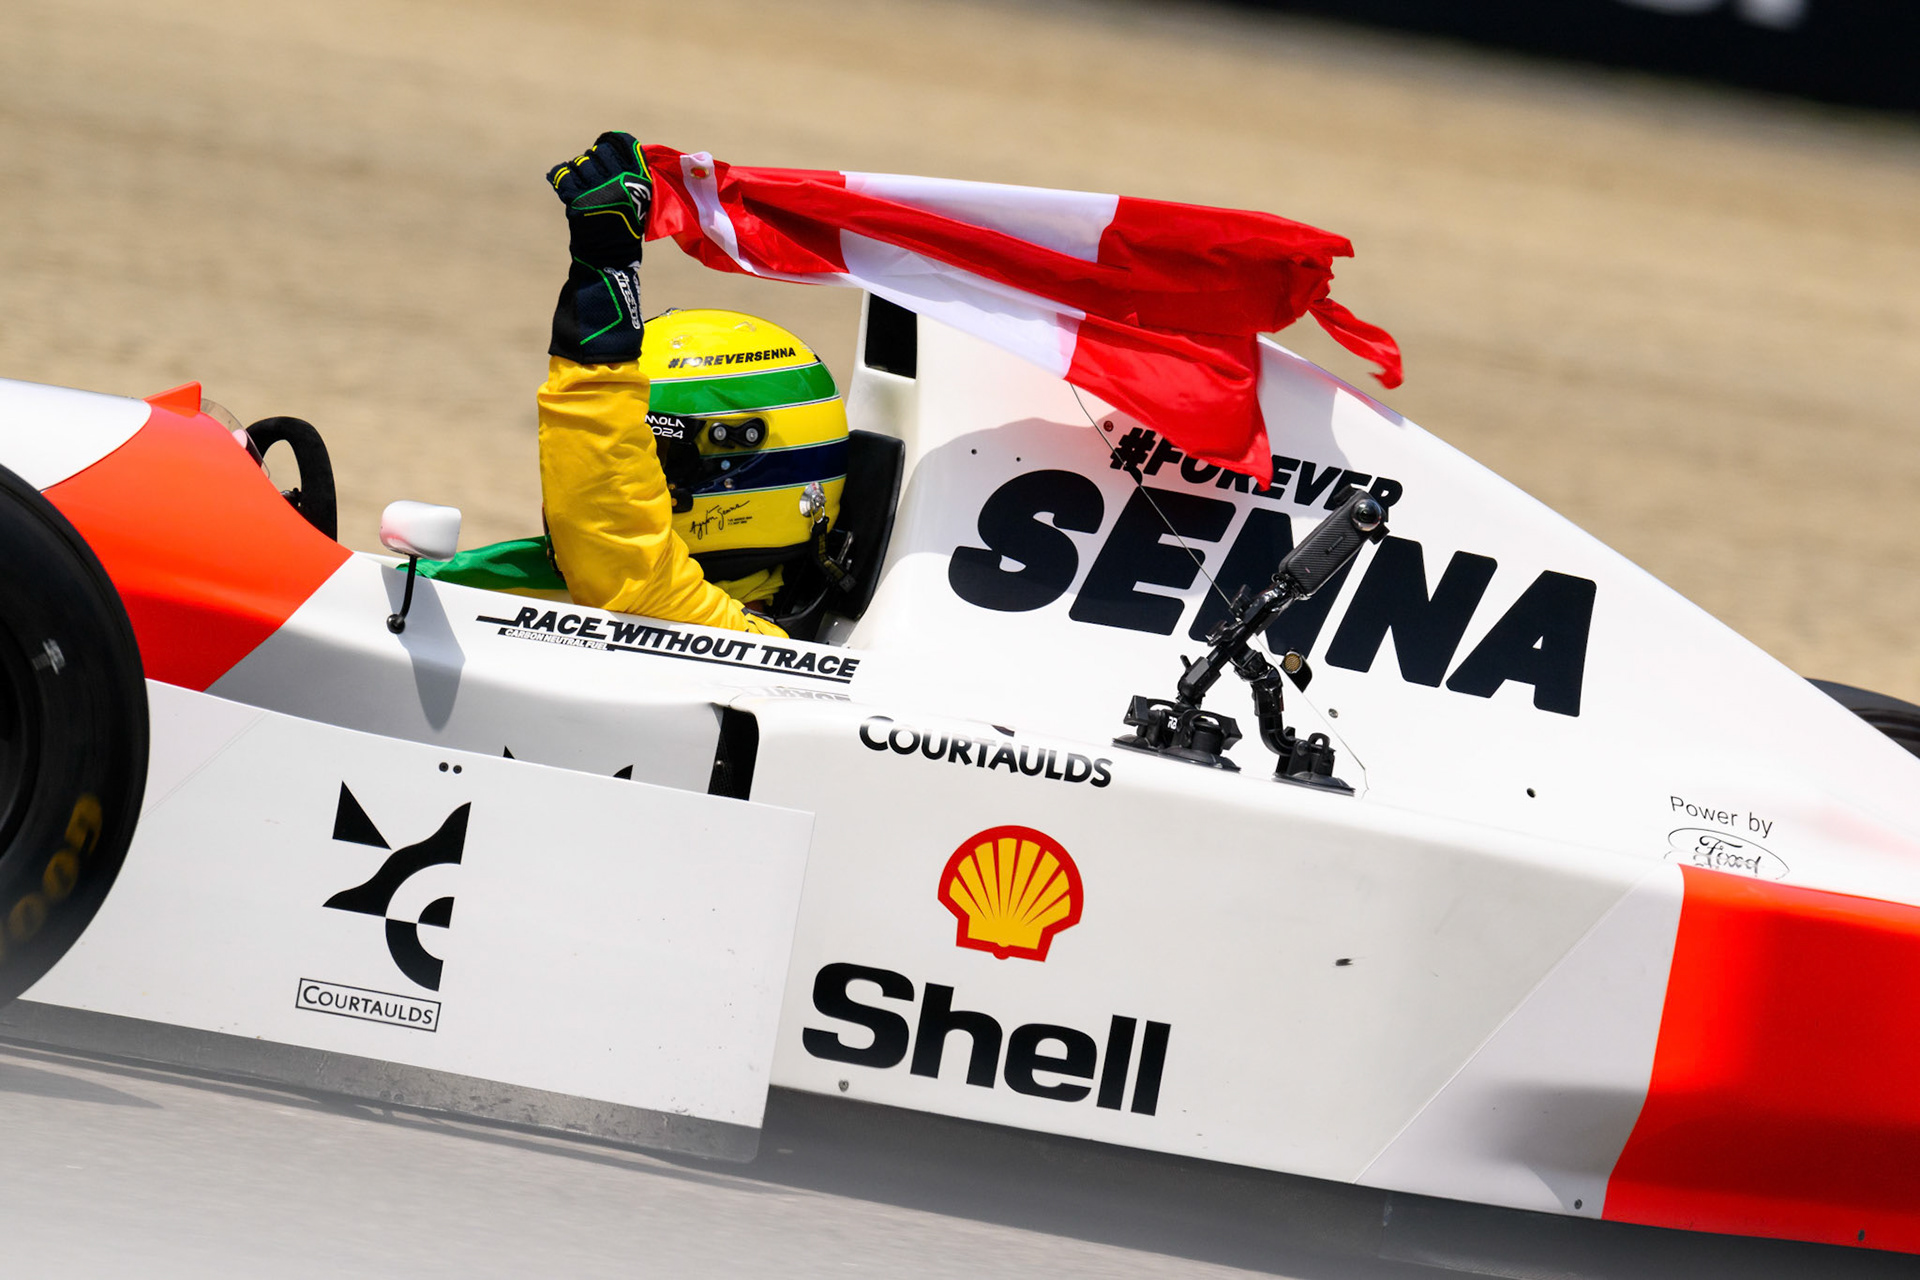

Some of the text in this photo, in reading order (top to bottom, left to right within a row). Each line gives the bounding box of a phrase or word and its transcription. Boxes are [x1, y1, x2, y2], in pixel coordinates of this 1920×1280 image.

[668, 347, 796, 369] #FOREVERSENNA
[645, 414, 685, 428] MOLA
[651, 425, 684, 439] 024
[948, 469, 1596, 717] SENNA
[504, 628, 609, 651] CARBON NEUTRAL FUEL
[511, 606, 860, 678] RACE WITHOUT TRACE
[859, 715, 1114, 788] COURTAULDS
[1670, 795, 1773, 839] Power by
[302, 985, 434, 1025] COURTAULDS
[802, 962, 1172, 1116] Shell
